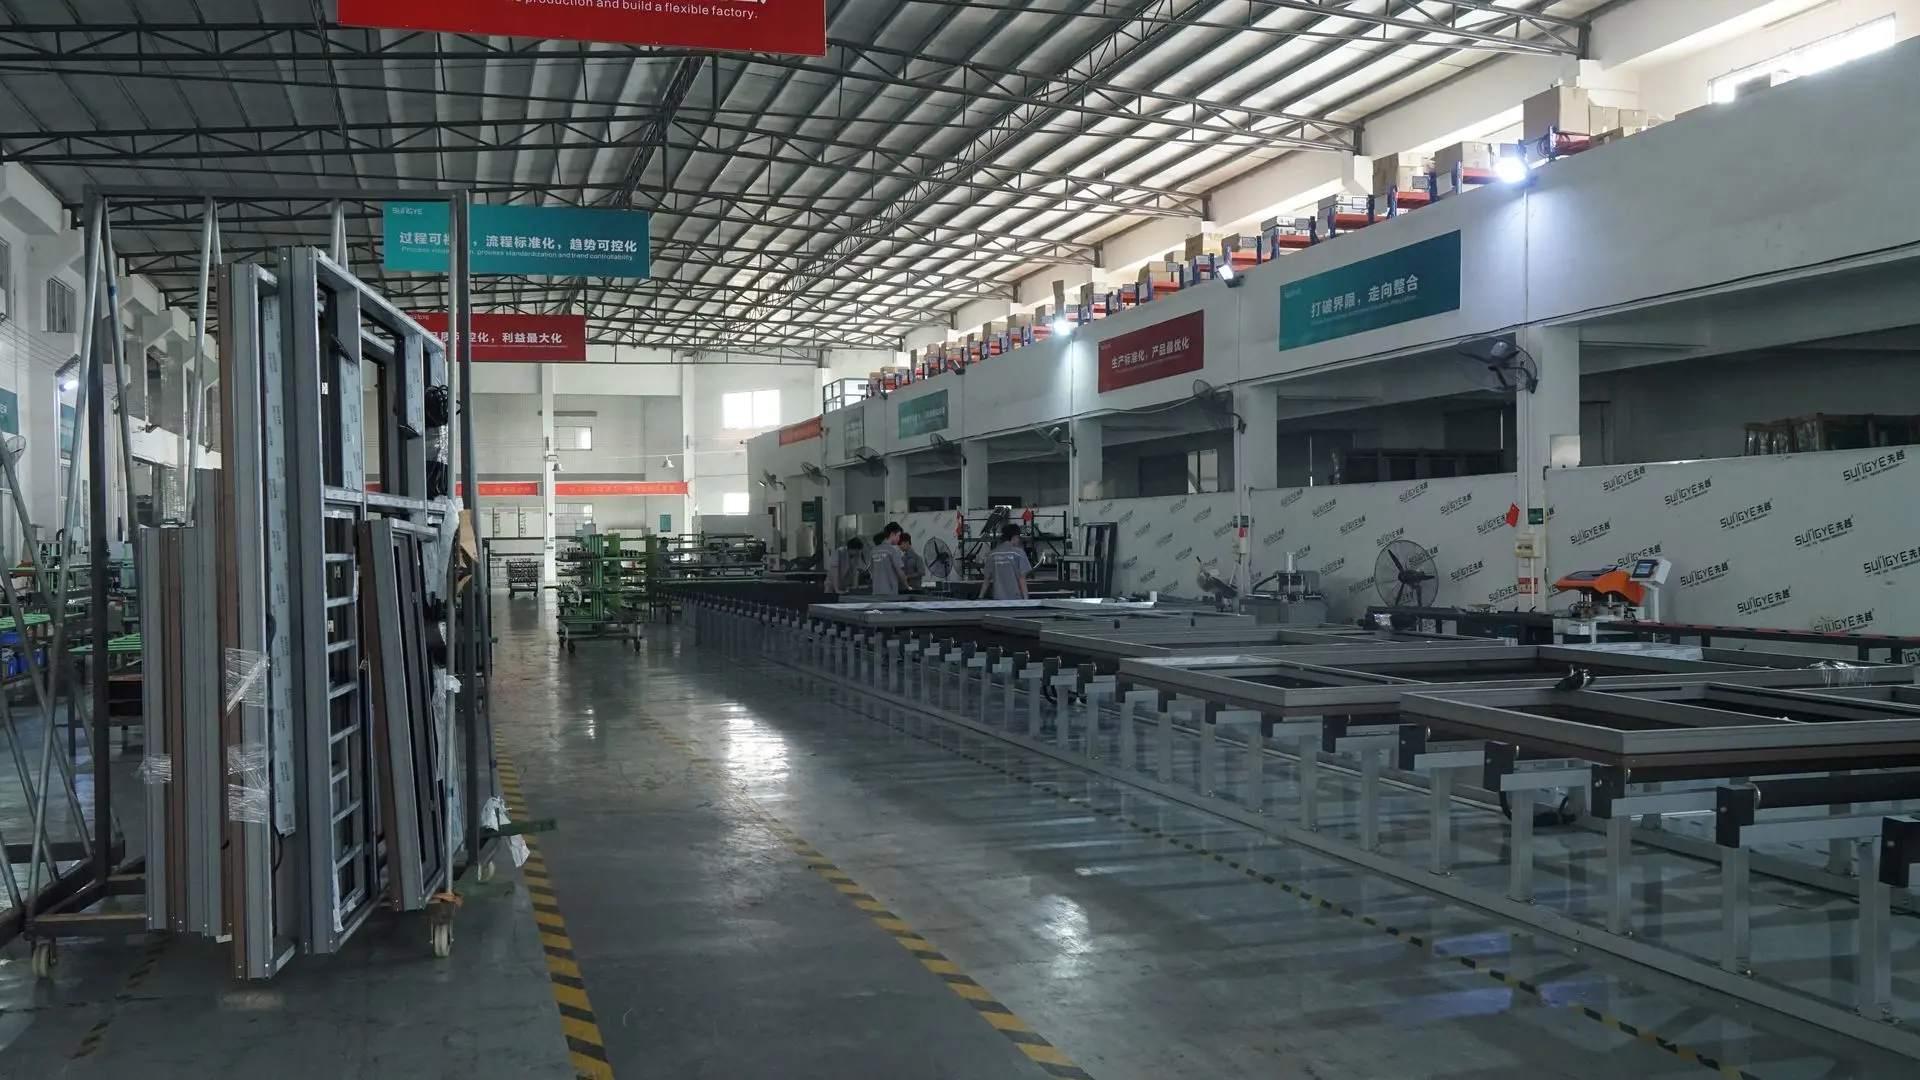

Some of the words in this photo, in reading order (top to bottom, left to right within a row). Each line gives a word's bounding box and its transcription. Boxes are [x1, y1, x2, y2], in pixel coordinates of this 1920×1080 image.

[596, 0, 619, 9] and
[622, 0, 652, 11] build
[655, 4, 662, 12] a
[665, 3, 709, 15] flexible
[712, 6, 758, 20] factory.
[400, 232, 638, 253] 过程可，流程标准化，趋势可控化
[1311, 274, 1419, 319] 打破界限，走向整合
